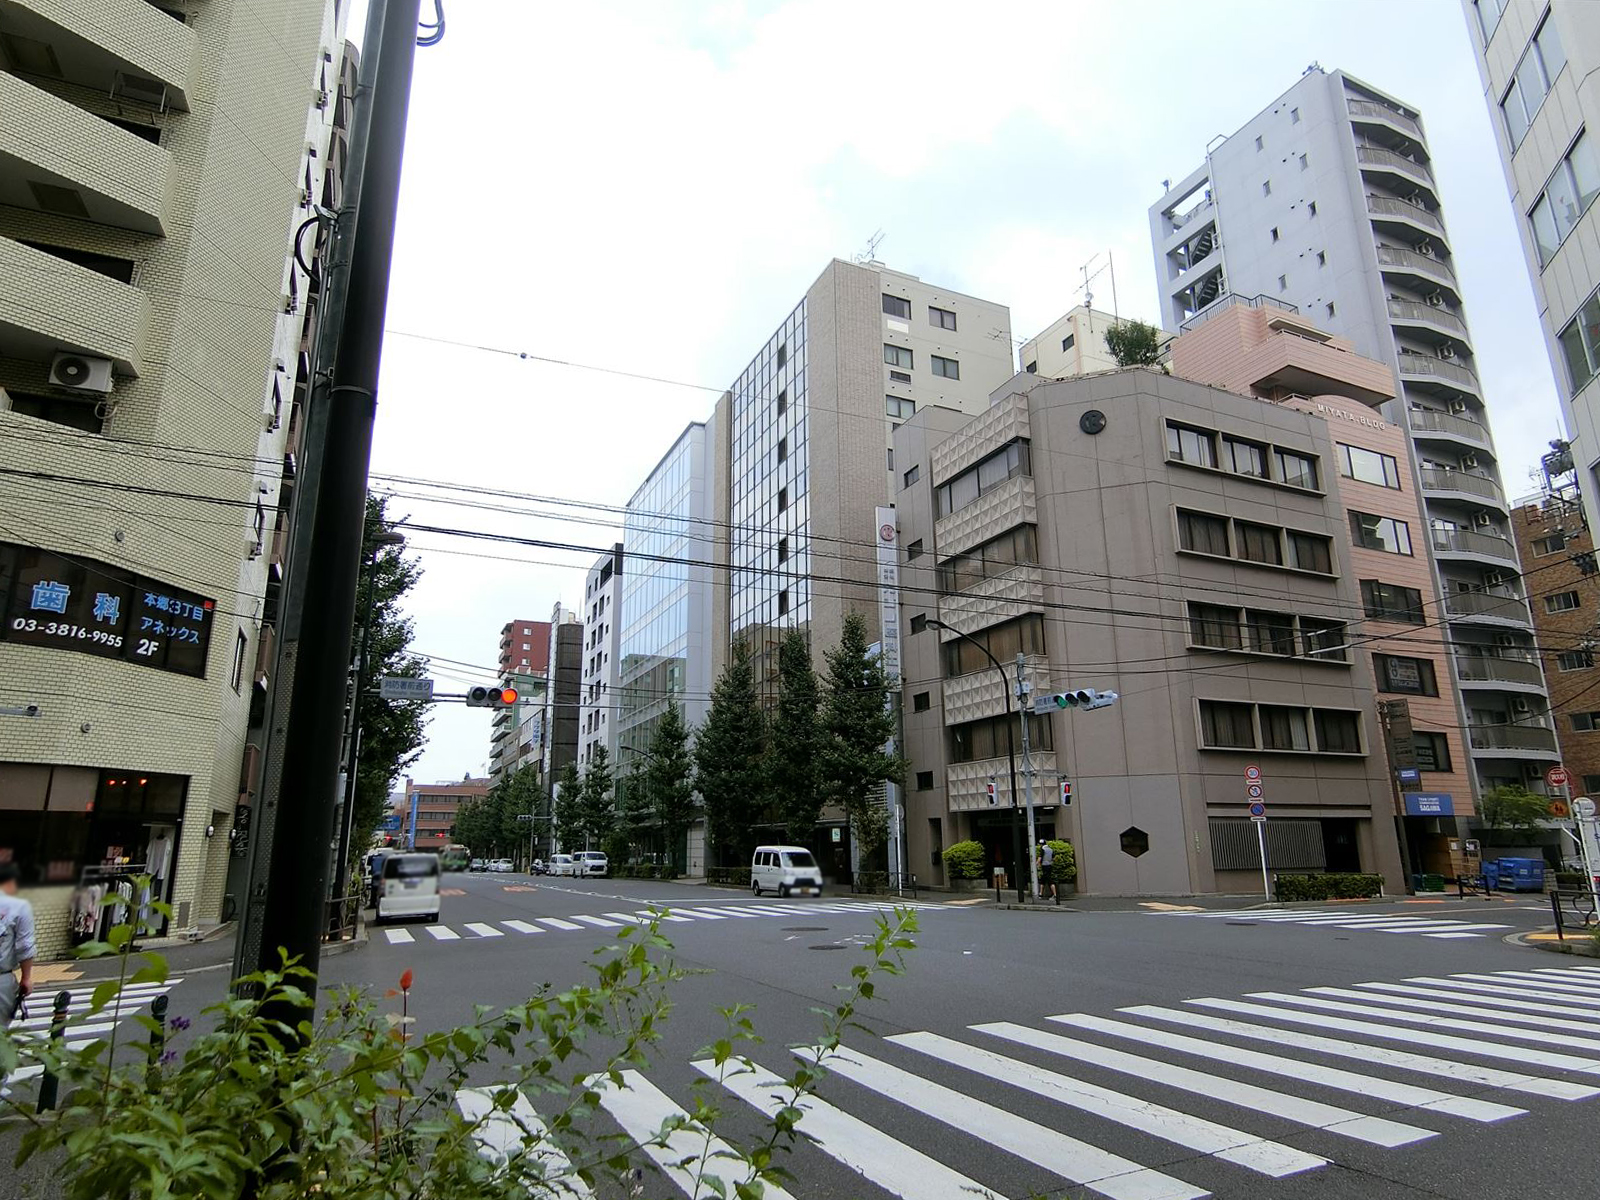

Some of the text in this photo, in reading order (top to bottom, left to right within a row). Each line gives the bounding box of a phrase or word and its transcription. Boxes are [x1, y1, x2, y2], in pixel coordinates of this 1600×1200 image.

[143, 592, 204, 622] 本郷3丁目
[13, 617, 124, 648] 03-3816-9955
[140, 616, 200, 644] アネックス
[136, 639, 160, 657] 2F
